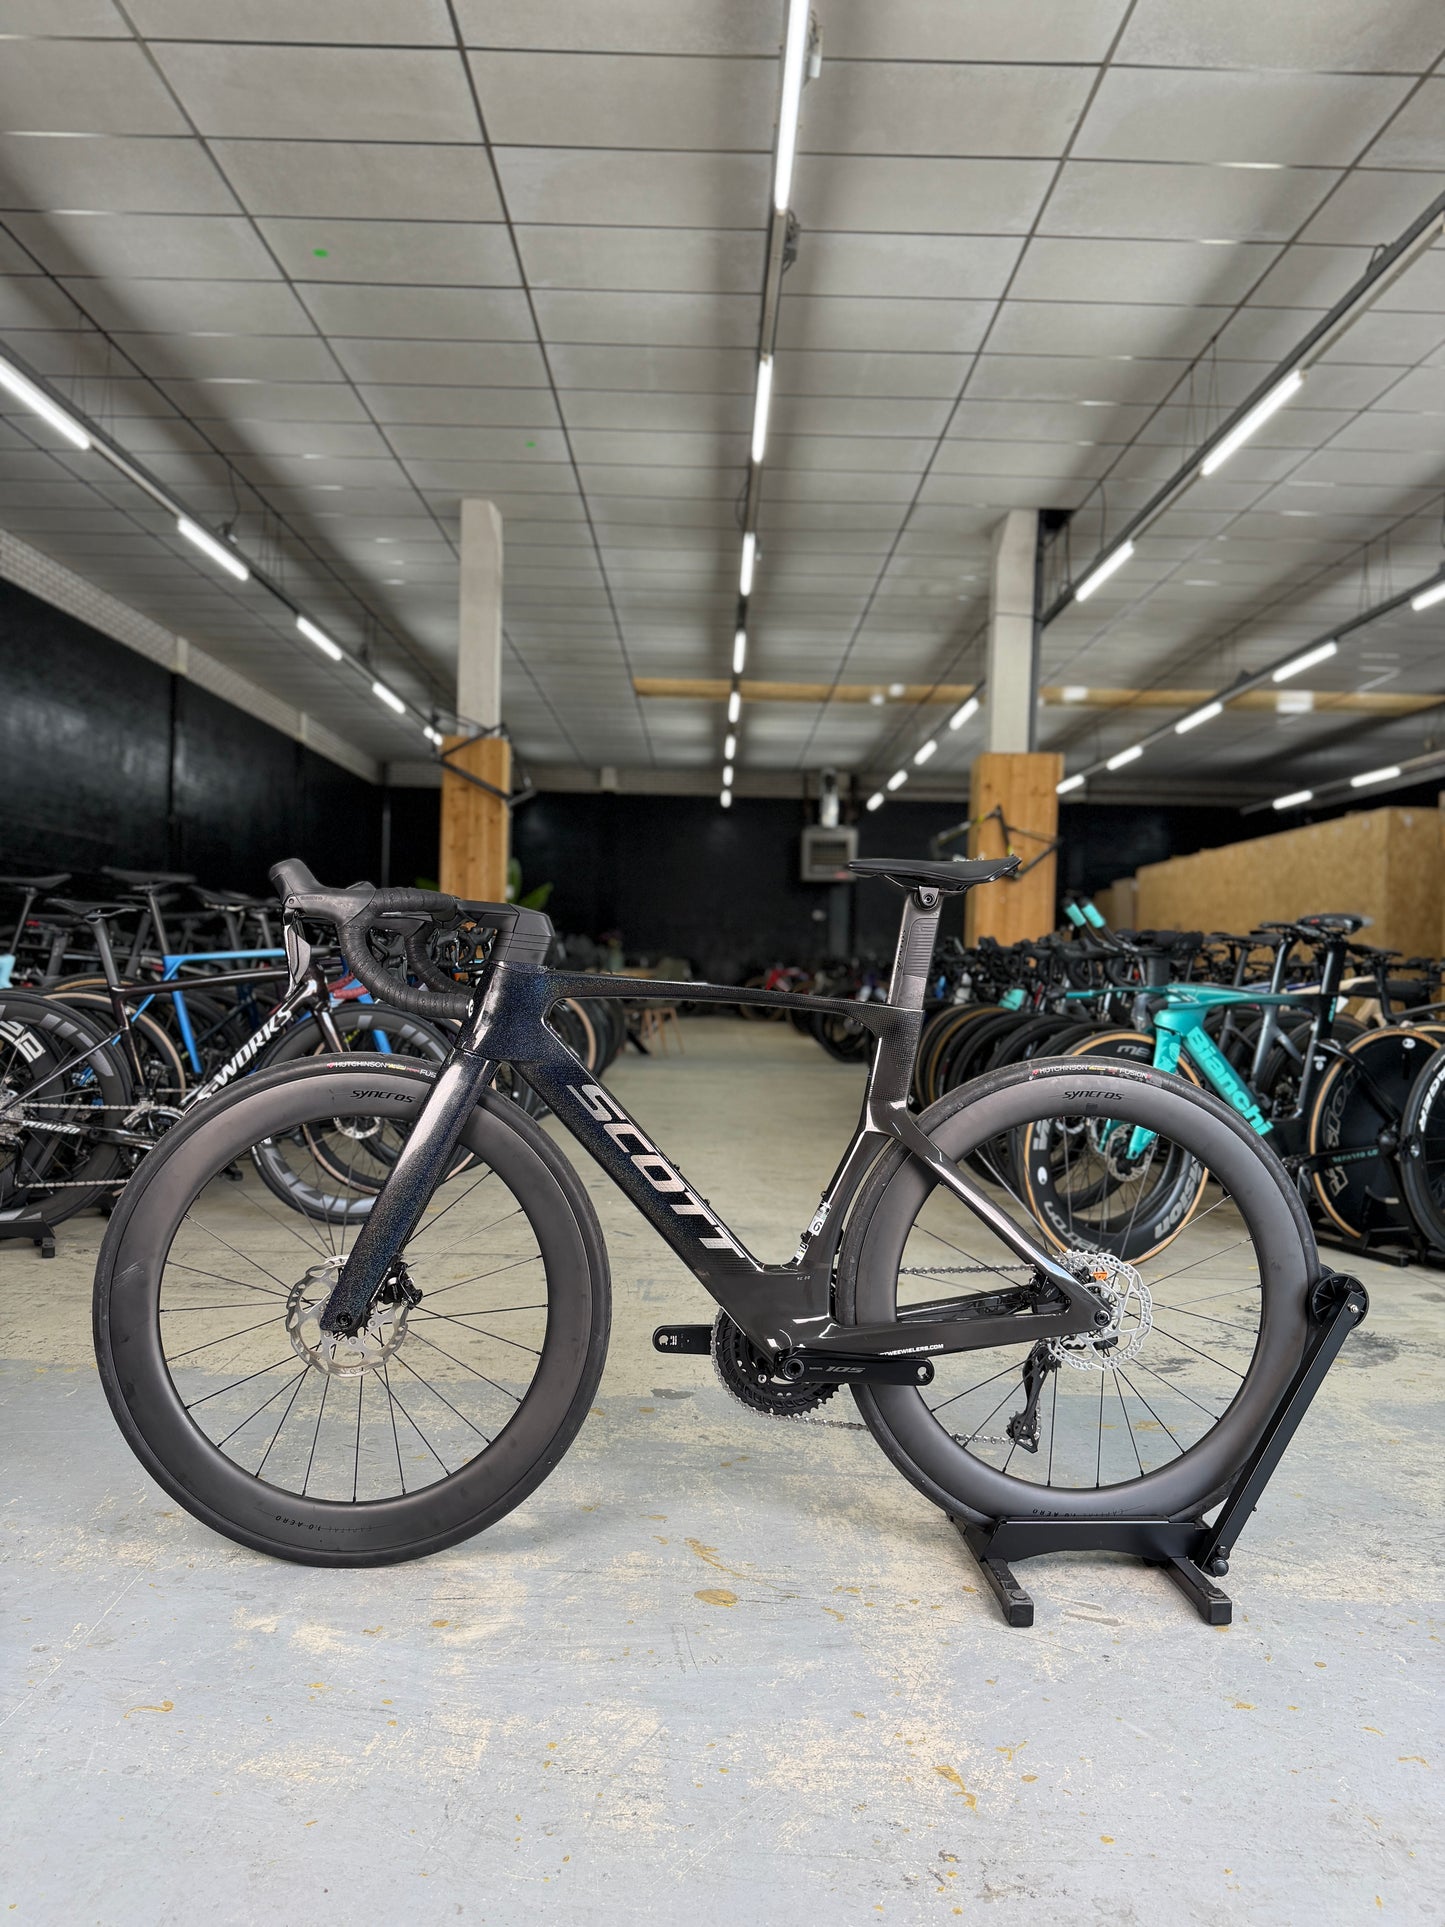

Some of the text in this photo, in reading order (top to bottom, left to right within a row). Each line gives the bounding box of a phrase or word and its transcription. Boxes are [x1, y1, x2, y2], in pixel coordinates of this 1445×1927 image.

[335, 1060, 387, 1069] HUTCHINSON
[420, 1069, 437, 1078] FUS
[1040, 1064, 1088, 1074] HUTCHINSON
[1120, 1068, 1147, 1078] FUSION
[1187, 1026, 1274, 1136] Bianchi
[566, 1084, 745, 1259] SCOTT
[878, 1344, 944, 1356] WEEWIELERS.COM
[825, 1366, 866, 1374] 105
[275, 1515, 304, 1528] AERO
